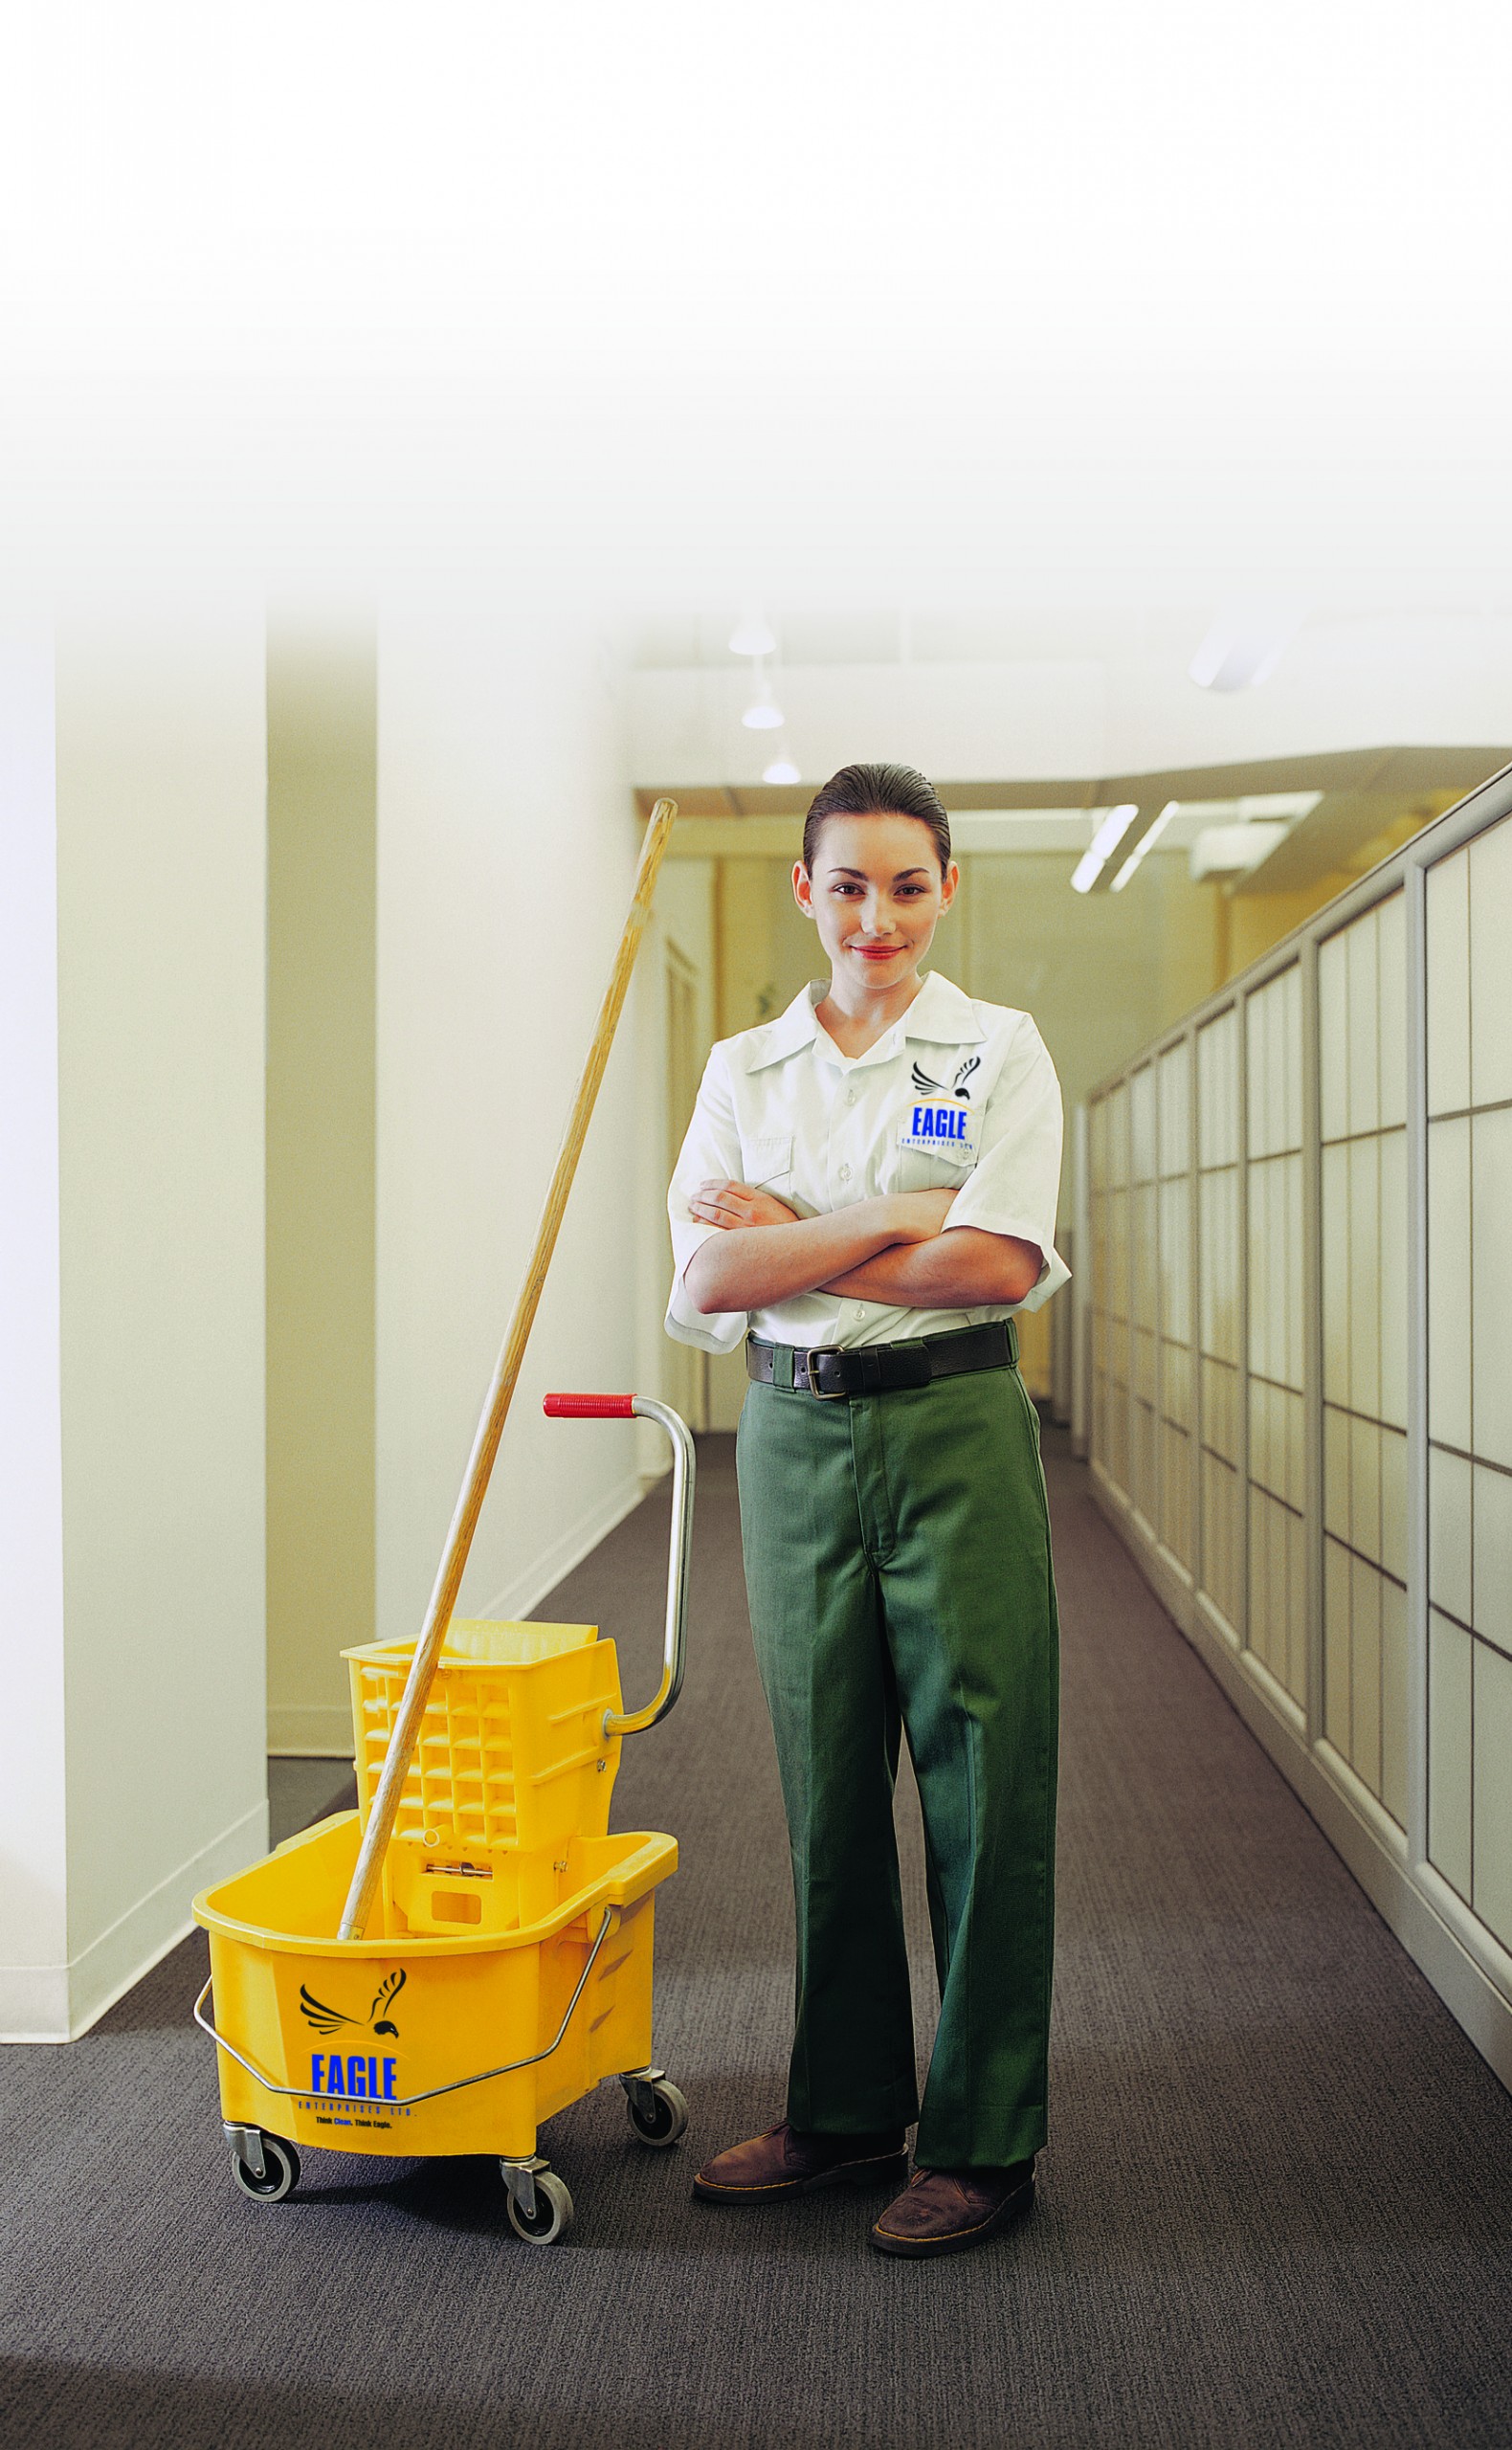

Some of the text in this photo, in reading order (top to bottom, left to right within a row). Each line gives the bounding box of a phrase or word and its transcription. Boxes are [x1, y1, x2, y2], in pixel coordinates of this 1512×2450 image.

[912, 1107, 967, 1140] EAGLE
[311, 2054, 397, 2101] EAGLE
[299, 2101, 380, 2114] ENTERPRISES
[316, 2116, 332, 2125] Think
[355, 2119, 371, 2127] Think
[373, 2120, 392, 2129] Eagle.
